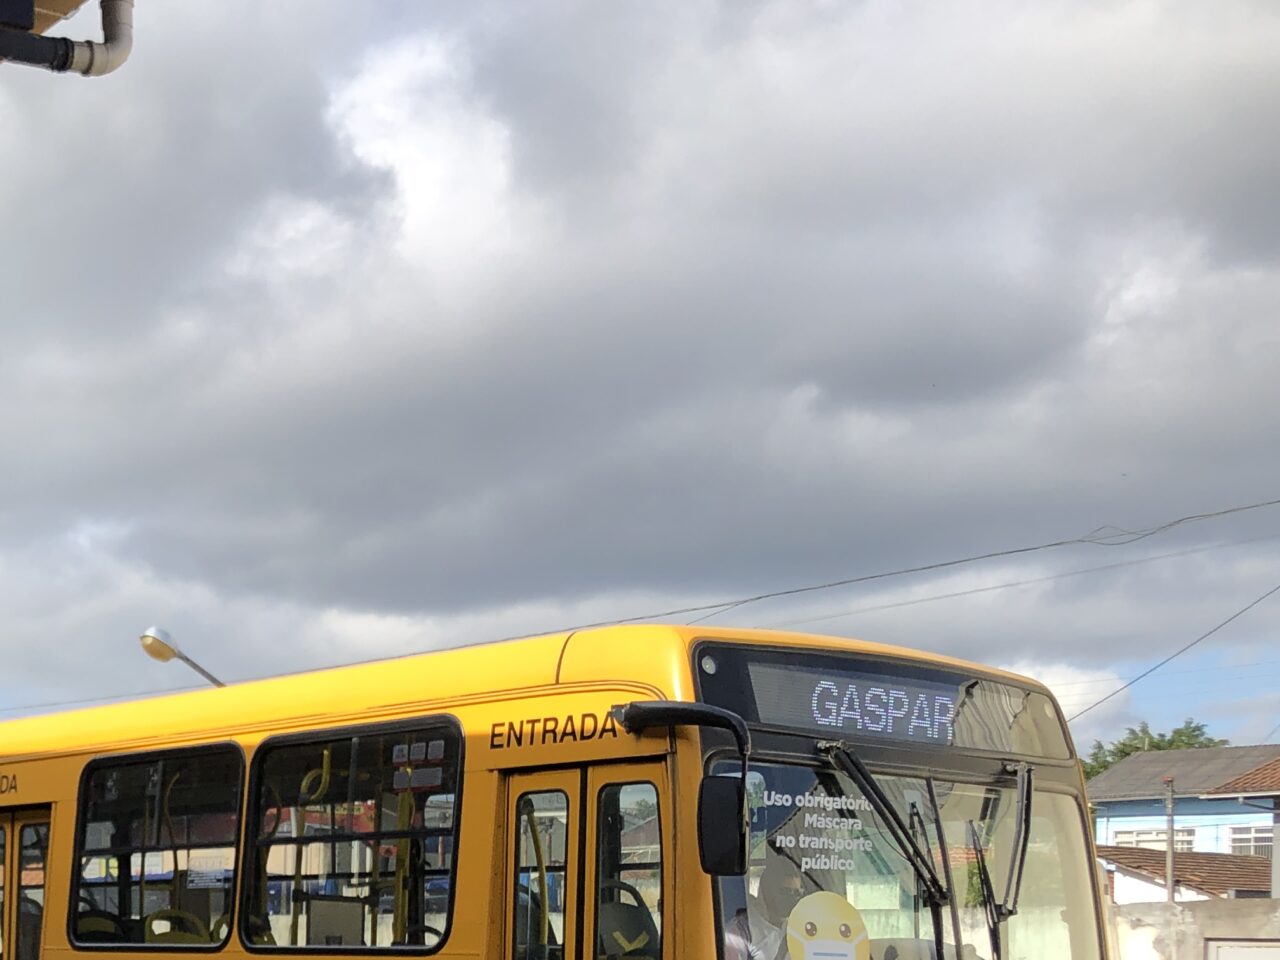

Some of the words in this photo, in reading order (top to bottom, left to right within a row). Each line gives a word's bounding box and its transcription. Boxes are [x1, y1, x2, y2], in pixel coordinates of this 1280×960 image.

[812, 680, 954, 740] GASPAR
[490, 711, 618, 749] ENTRADA
[763, 791, 792, 807] Uso
[795, 792, 874, 811] obrigatóri
[804, 813, 863, 830] Máscara
[776, 835, 796, 847] no
[798, 834, 873, 852] transporte
[801, 854, 856, 872] público
